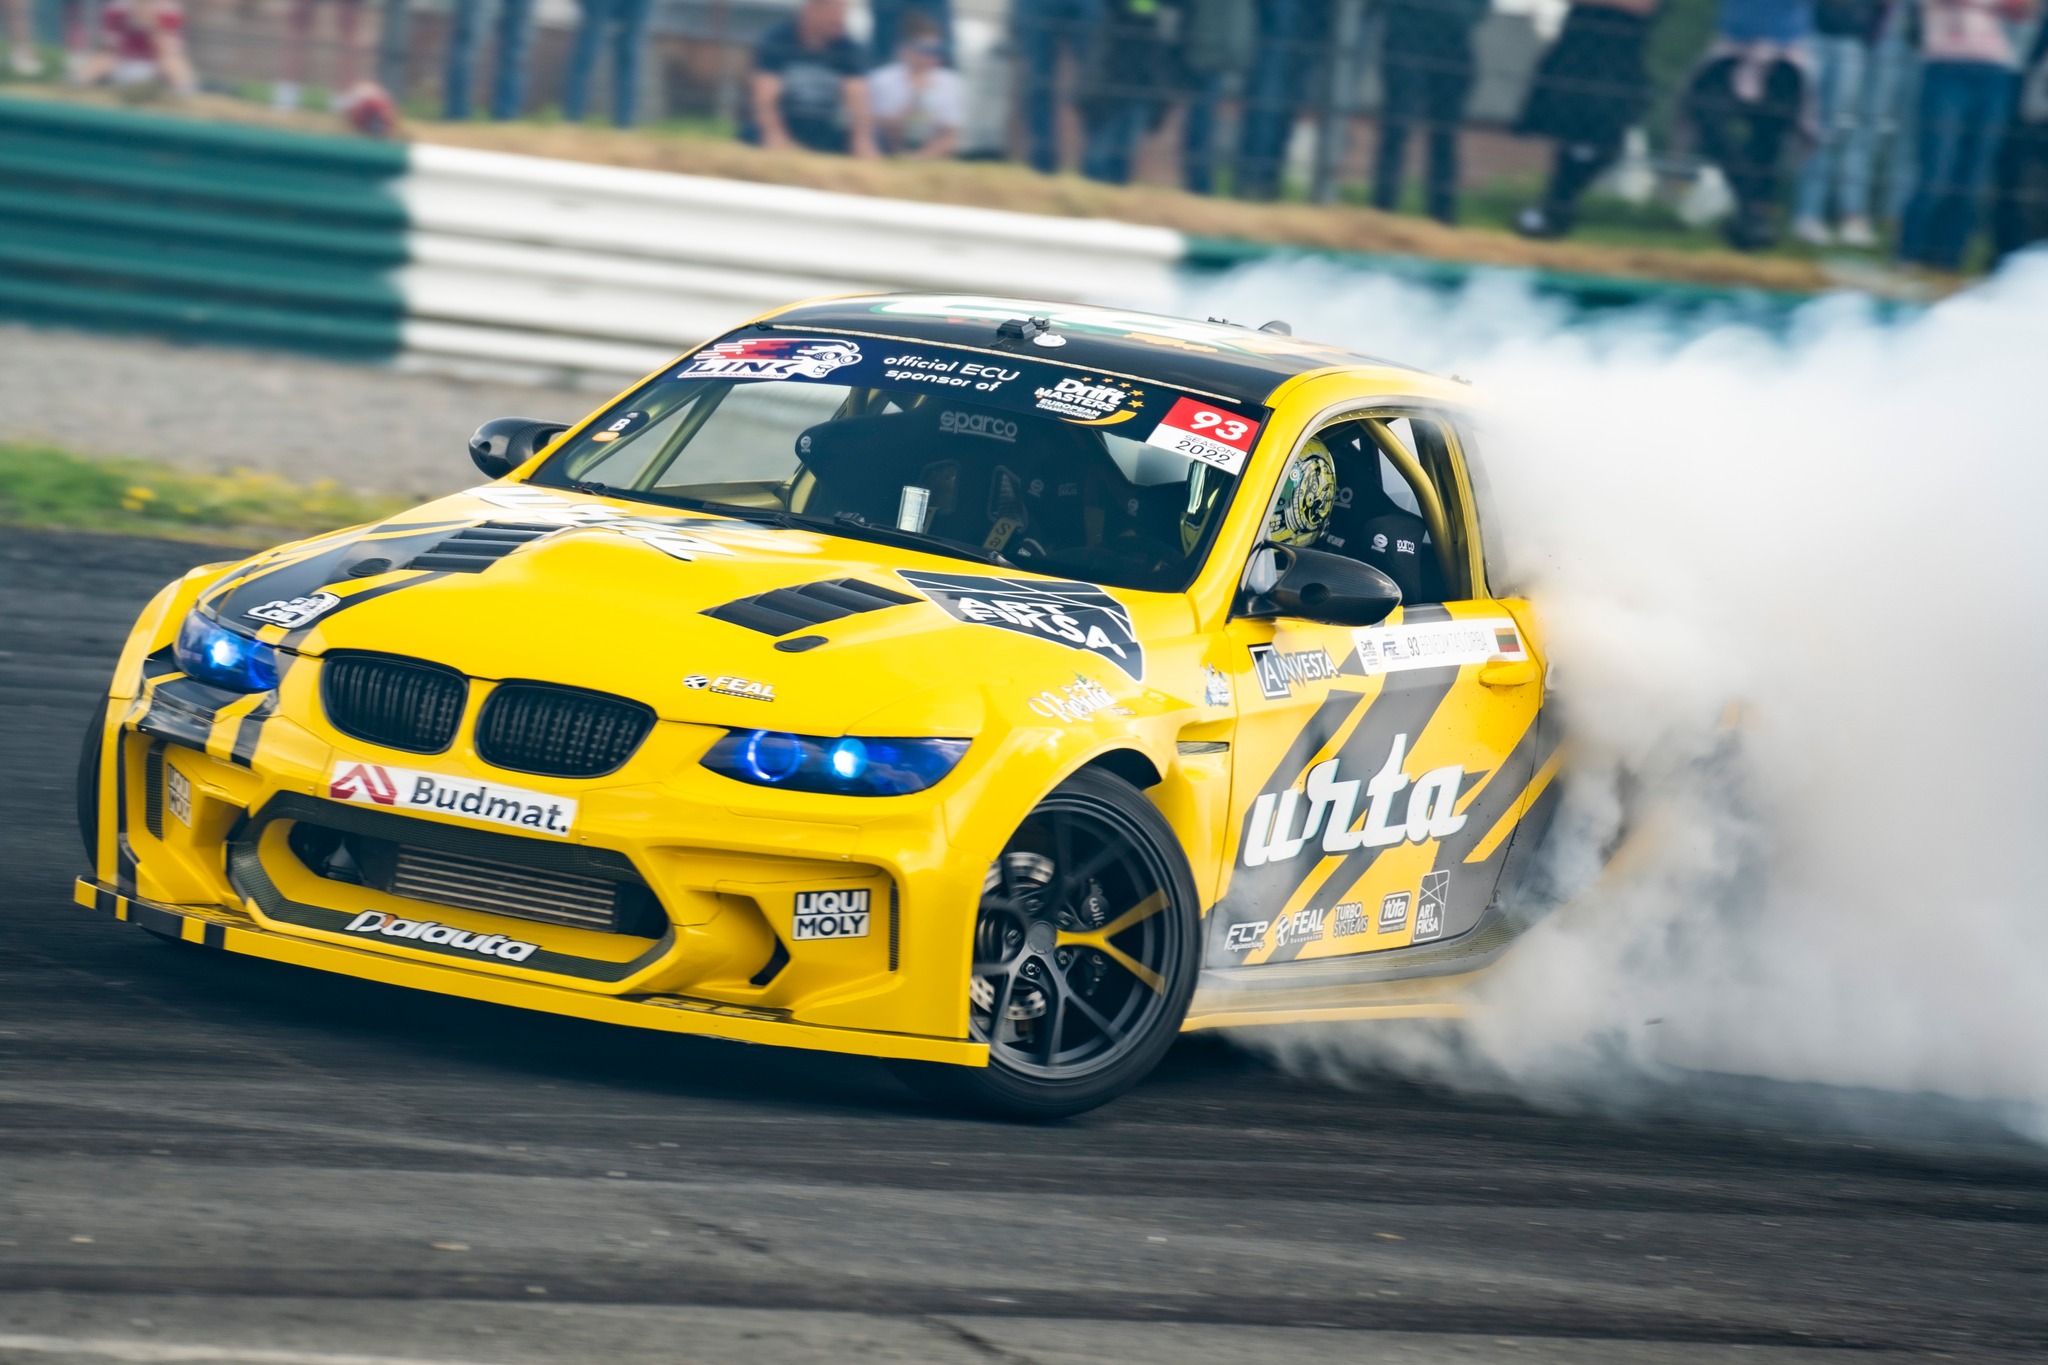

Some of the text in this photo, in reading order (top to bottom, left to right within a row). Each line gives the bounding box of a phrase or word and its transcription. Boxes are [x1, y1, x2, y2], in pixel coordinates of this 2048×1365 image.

[883, 355, 1021, 381] official ECU
[885, 370, 1002, 391] sponsor of
[1054, 378, 1127, 405] Drift
[1034, 387, 1117, 412] MASTERS
[1039, 398, 1102, 416] EUROPEAN
[1035, 403, 1098, 420] CHAMPIONSHIP
[939, 411, 1018, 442] sparco
[1190, 411, 1248, 440] 93
[1175, 440, 1230, 465] 2022
[1184, 435, 1237, 457] SEASON
[958, 597, 1064, 615] ART
[960, 608, 1128, 659] FIKSA
[1407, 637, 1420, 656] 93
[711, 676, 776, 697] FEAL
[409, 776, 569, 833] Budmat.
[1243, 733, 1468, 867] urta
[796, 890, 869, 914] LIQUI
[1336, 902, 1362, 920] TURBO
[1418, 903, 1436, 920] ART
[796, 915, 866, 938] MOLY
[1290, 908, 1324, 935] FEAL
[1333, 916, 1368, 937] SYSTEMS
[1416, 917, 1439, 935] FIKSA
